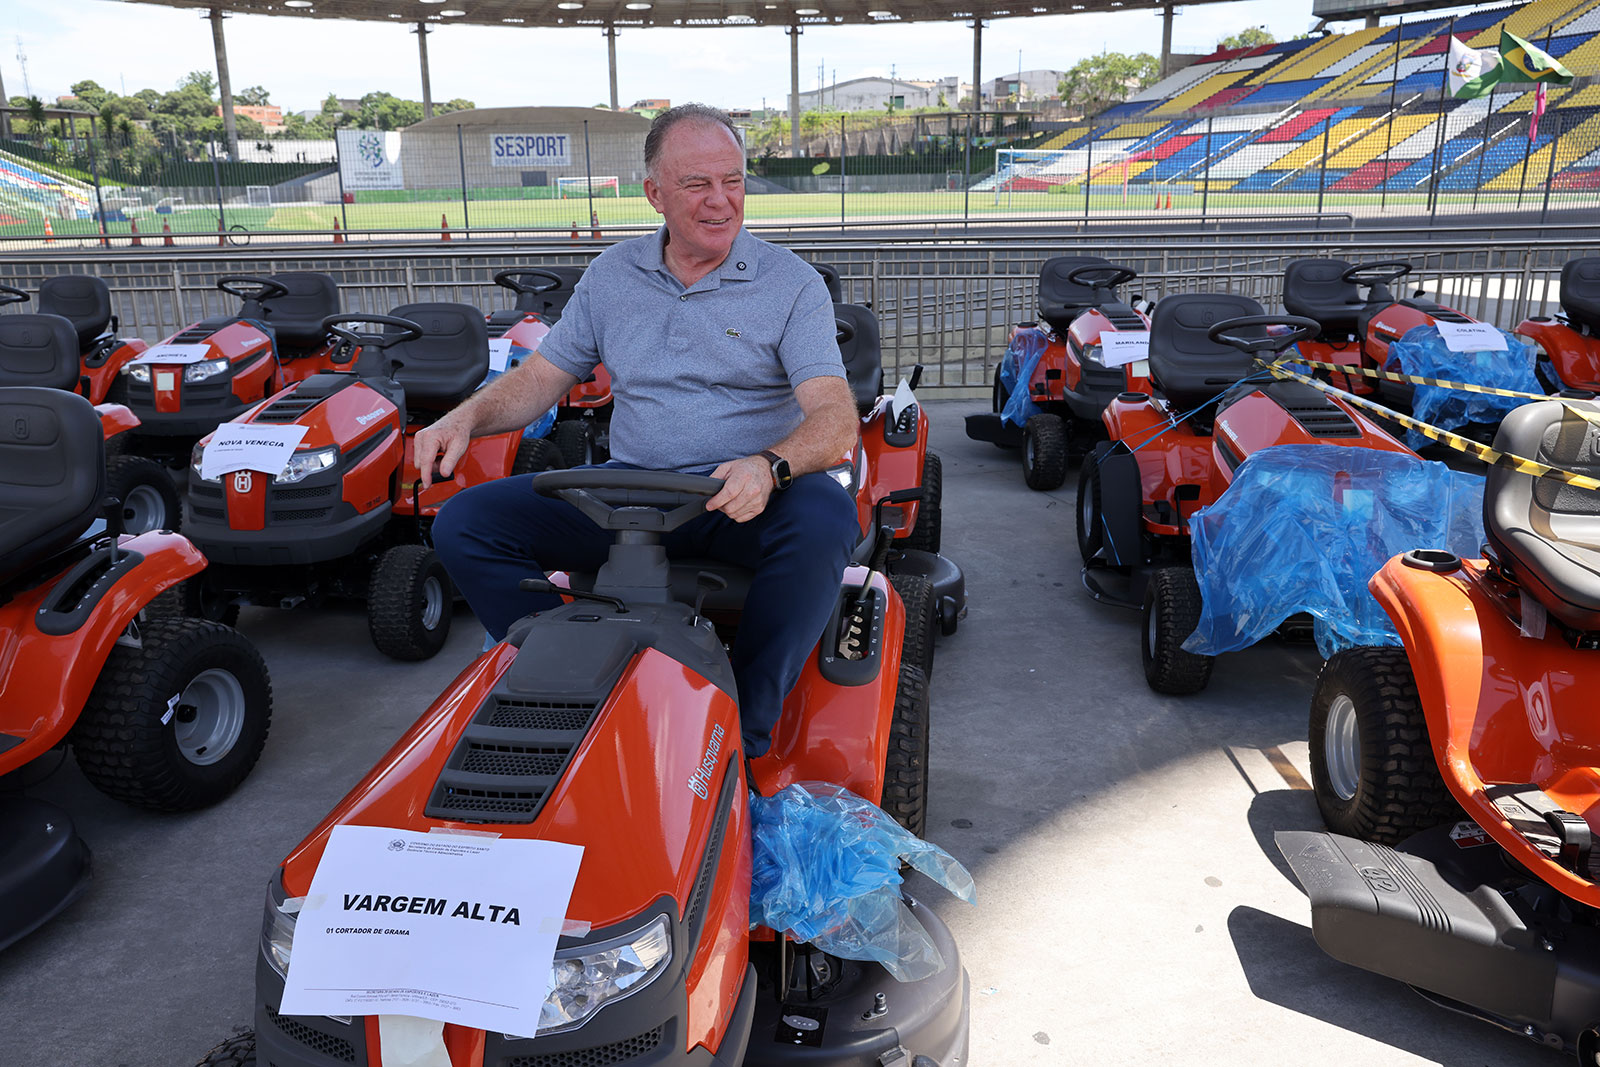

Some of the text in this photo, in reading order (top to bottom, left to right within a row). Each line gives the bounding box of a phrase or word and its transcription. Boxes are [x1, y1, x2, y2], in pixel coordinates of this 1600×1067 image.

[495, 136, 566, 157] SESPORT
[245, 440, 285, 448] VENECIA
[694, 723, 725, 786] Husqvarna
[343, 894, 521, 926] VARGEM ALTA
[335, 927, 372, 935] CORTADOR
[384, 928, 410, 936] GRAMA
